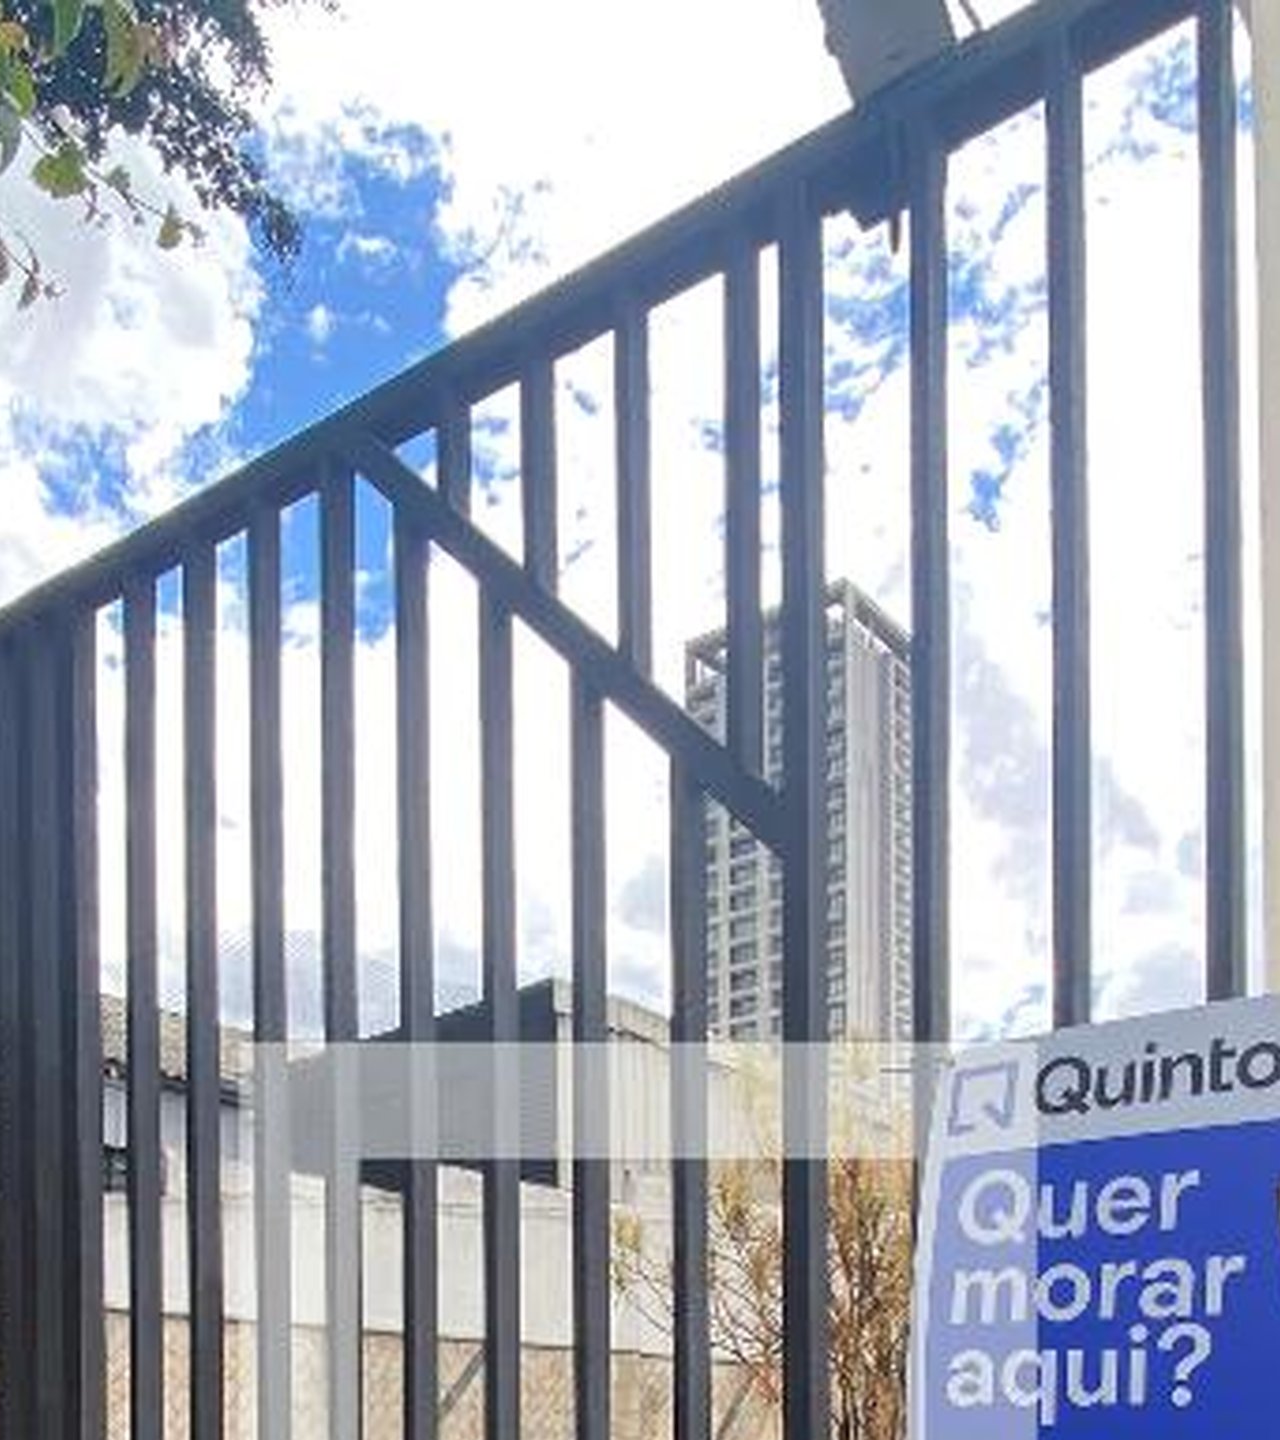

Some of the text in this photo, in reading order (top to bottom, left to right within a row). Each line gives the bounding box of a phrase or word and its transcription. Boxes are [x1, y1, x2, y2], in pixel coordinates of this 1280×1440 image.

[958, 1169, 1200, 1246] Quer
[950, 1252, 1246, 1326] morar
[945, 1323, 1213, 1427] aqui?
